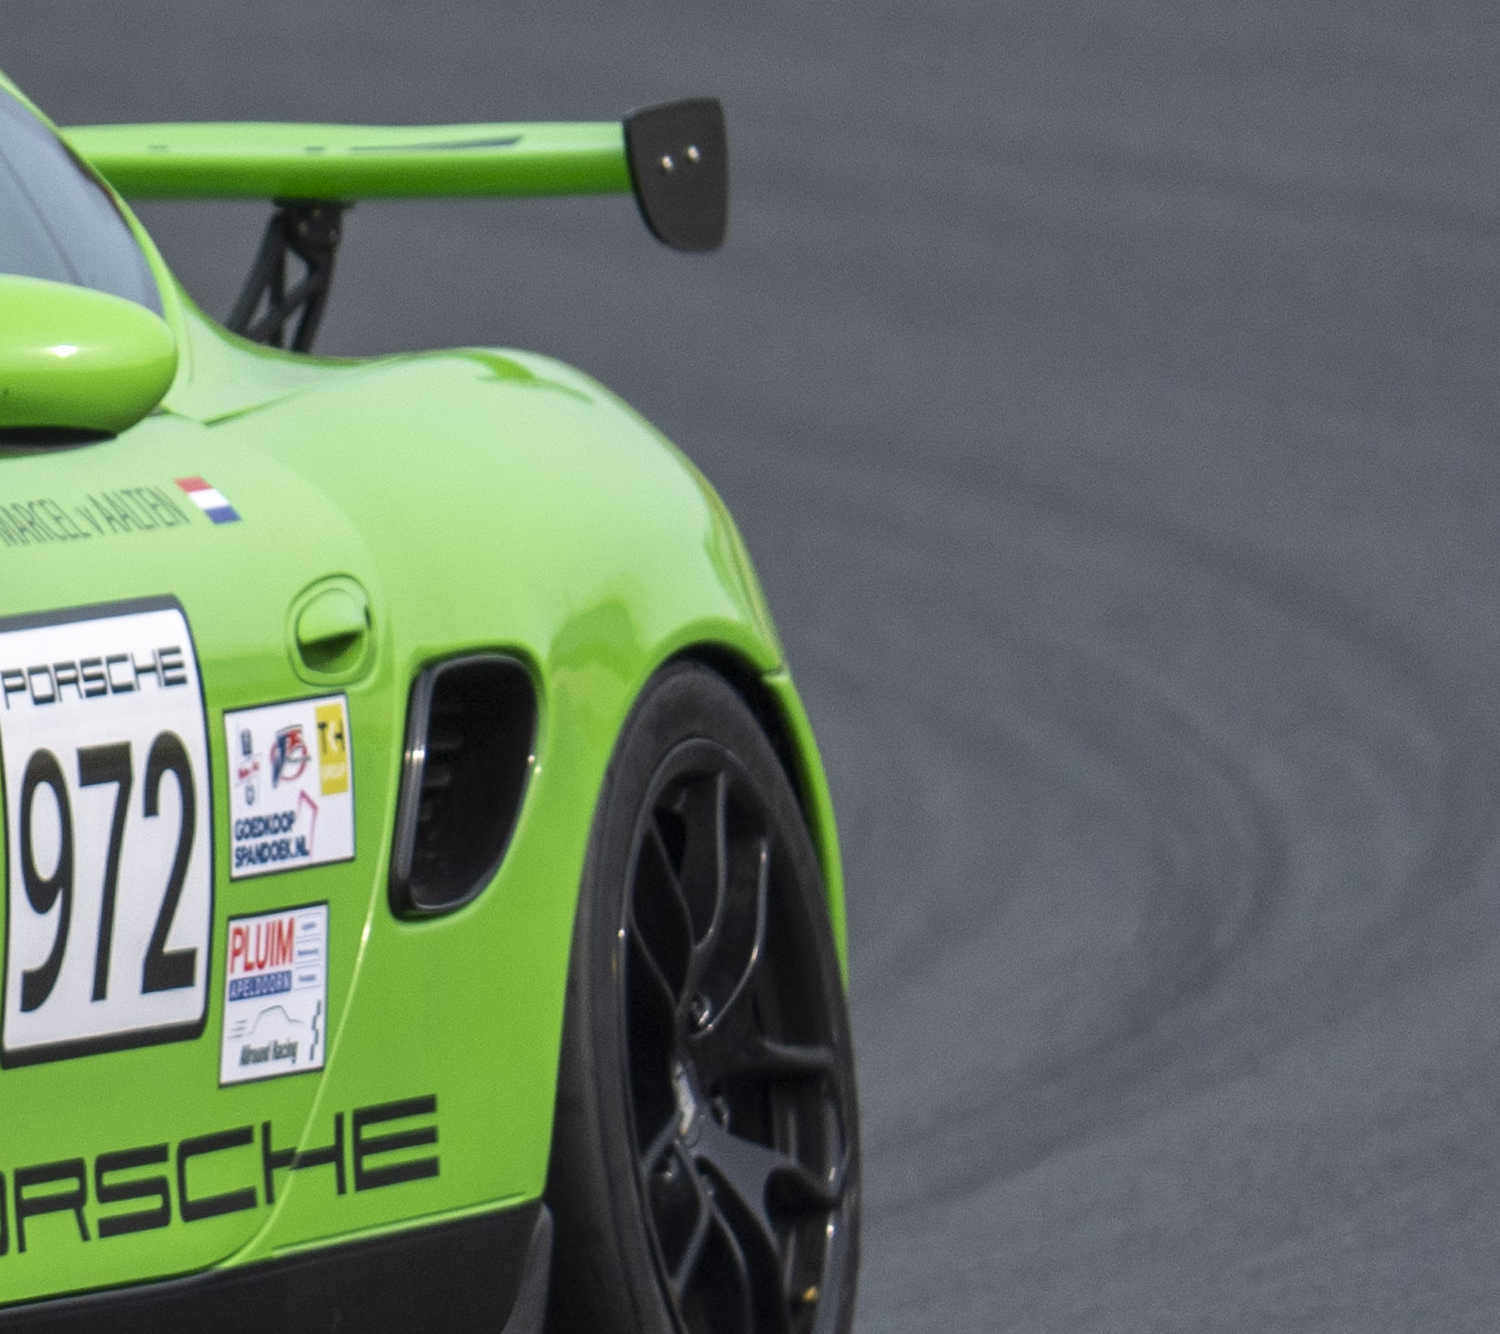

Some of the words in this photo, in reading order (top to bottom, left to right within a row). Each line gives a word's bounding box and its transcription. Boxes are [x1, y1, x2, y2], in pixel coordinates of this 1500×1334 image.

[86, 485, 191, 534] AALTEN
[0, 645, 188, 711] PORSCHE
[235, 810, 296, 842] GOEDKOOP
[18, 729, 198, 1014] 972
[235, 835, 311, 869] SPANDOEK.NL
[230, 917, 296, 975] PLUIM
[230, 975, 292, 999] APELDOORN
